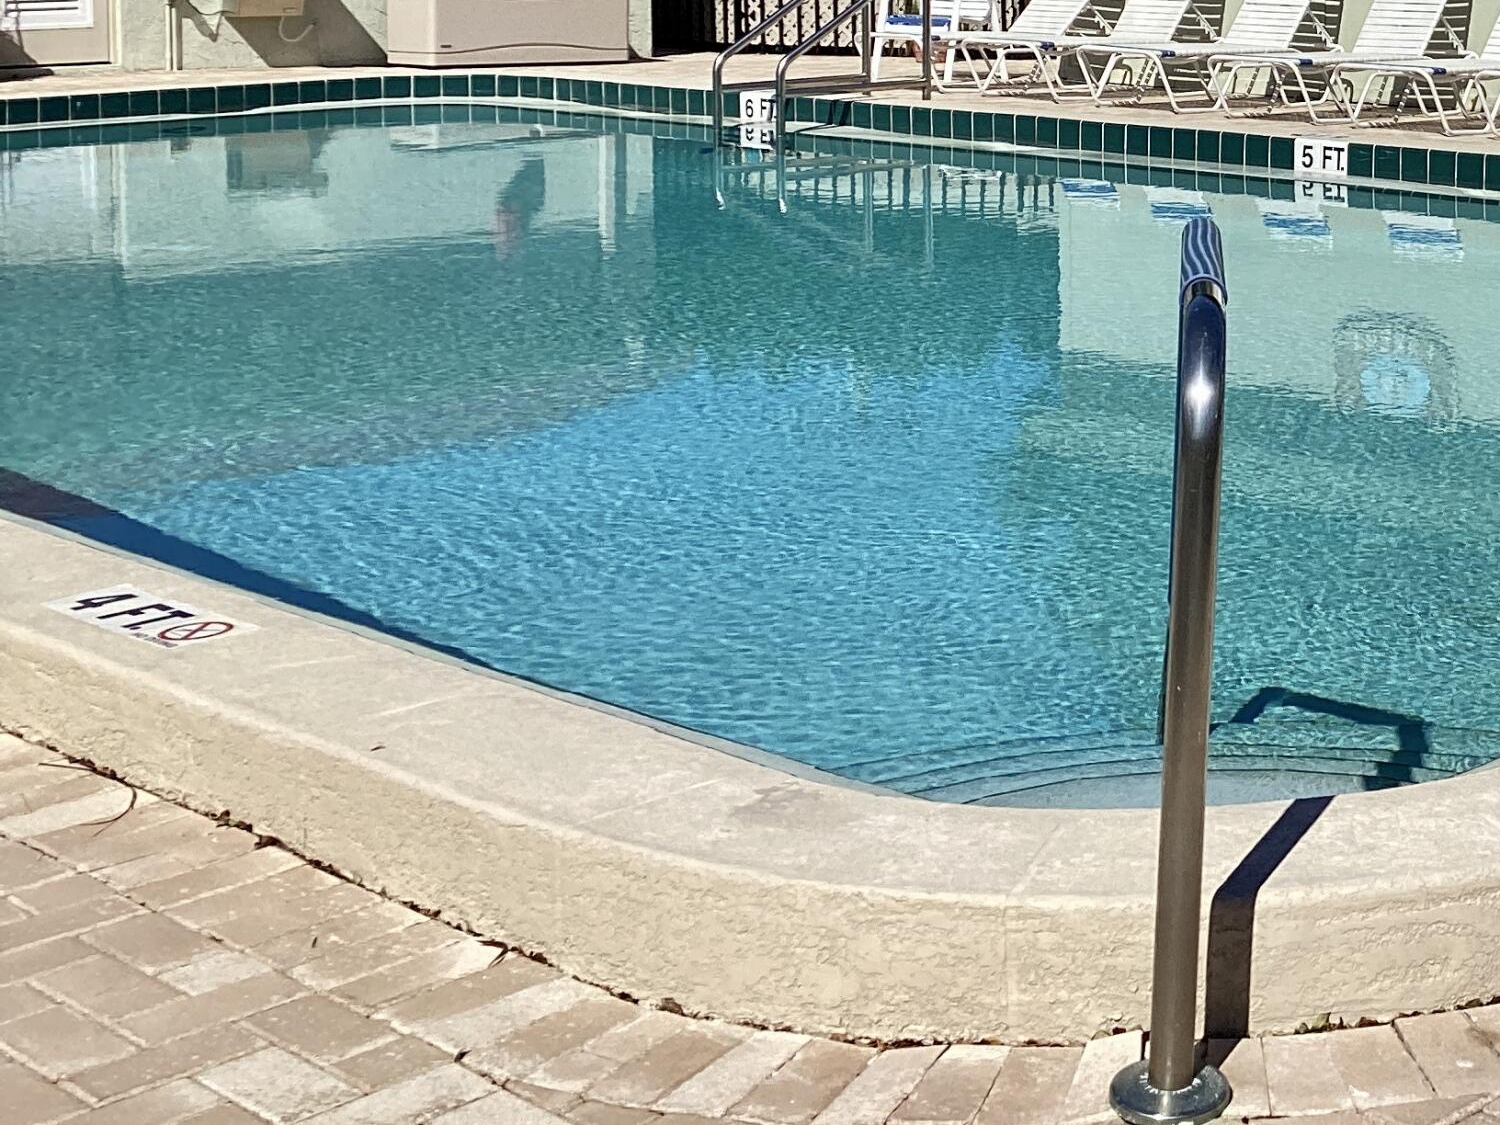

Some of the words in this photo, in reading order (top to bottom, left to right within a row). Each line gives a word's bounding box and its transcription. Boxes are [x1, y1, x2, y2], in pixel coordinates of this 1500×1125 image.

[745, 98, 754, 118] 6
[1301, 144, 1313, 168] 5
[1322, 145, 1345, 172] FT.
[69, 593, 139, 611] 4
[96, 603, 197, 631] FT.
